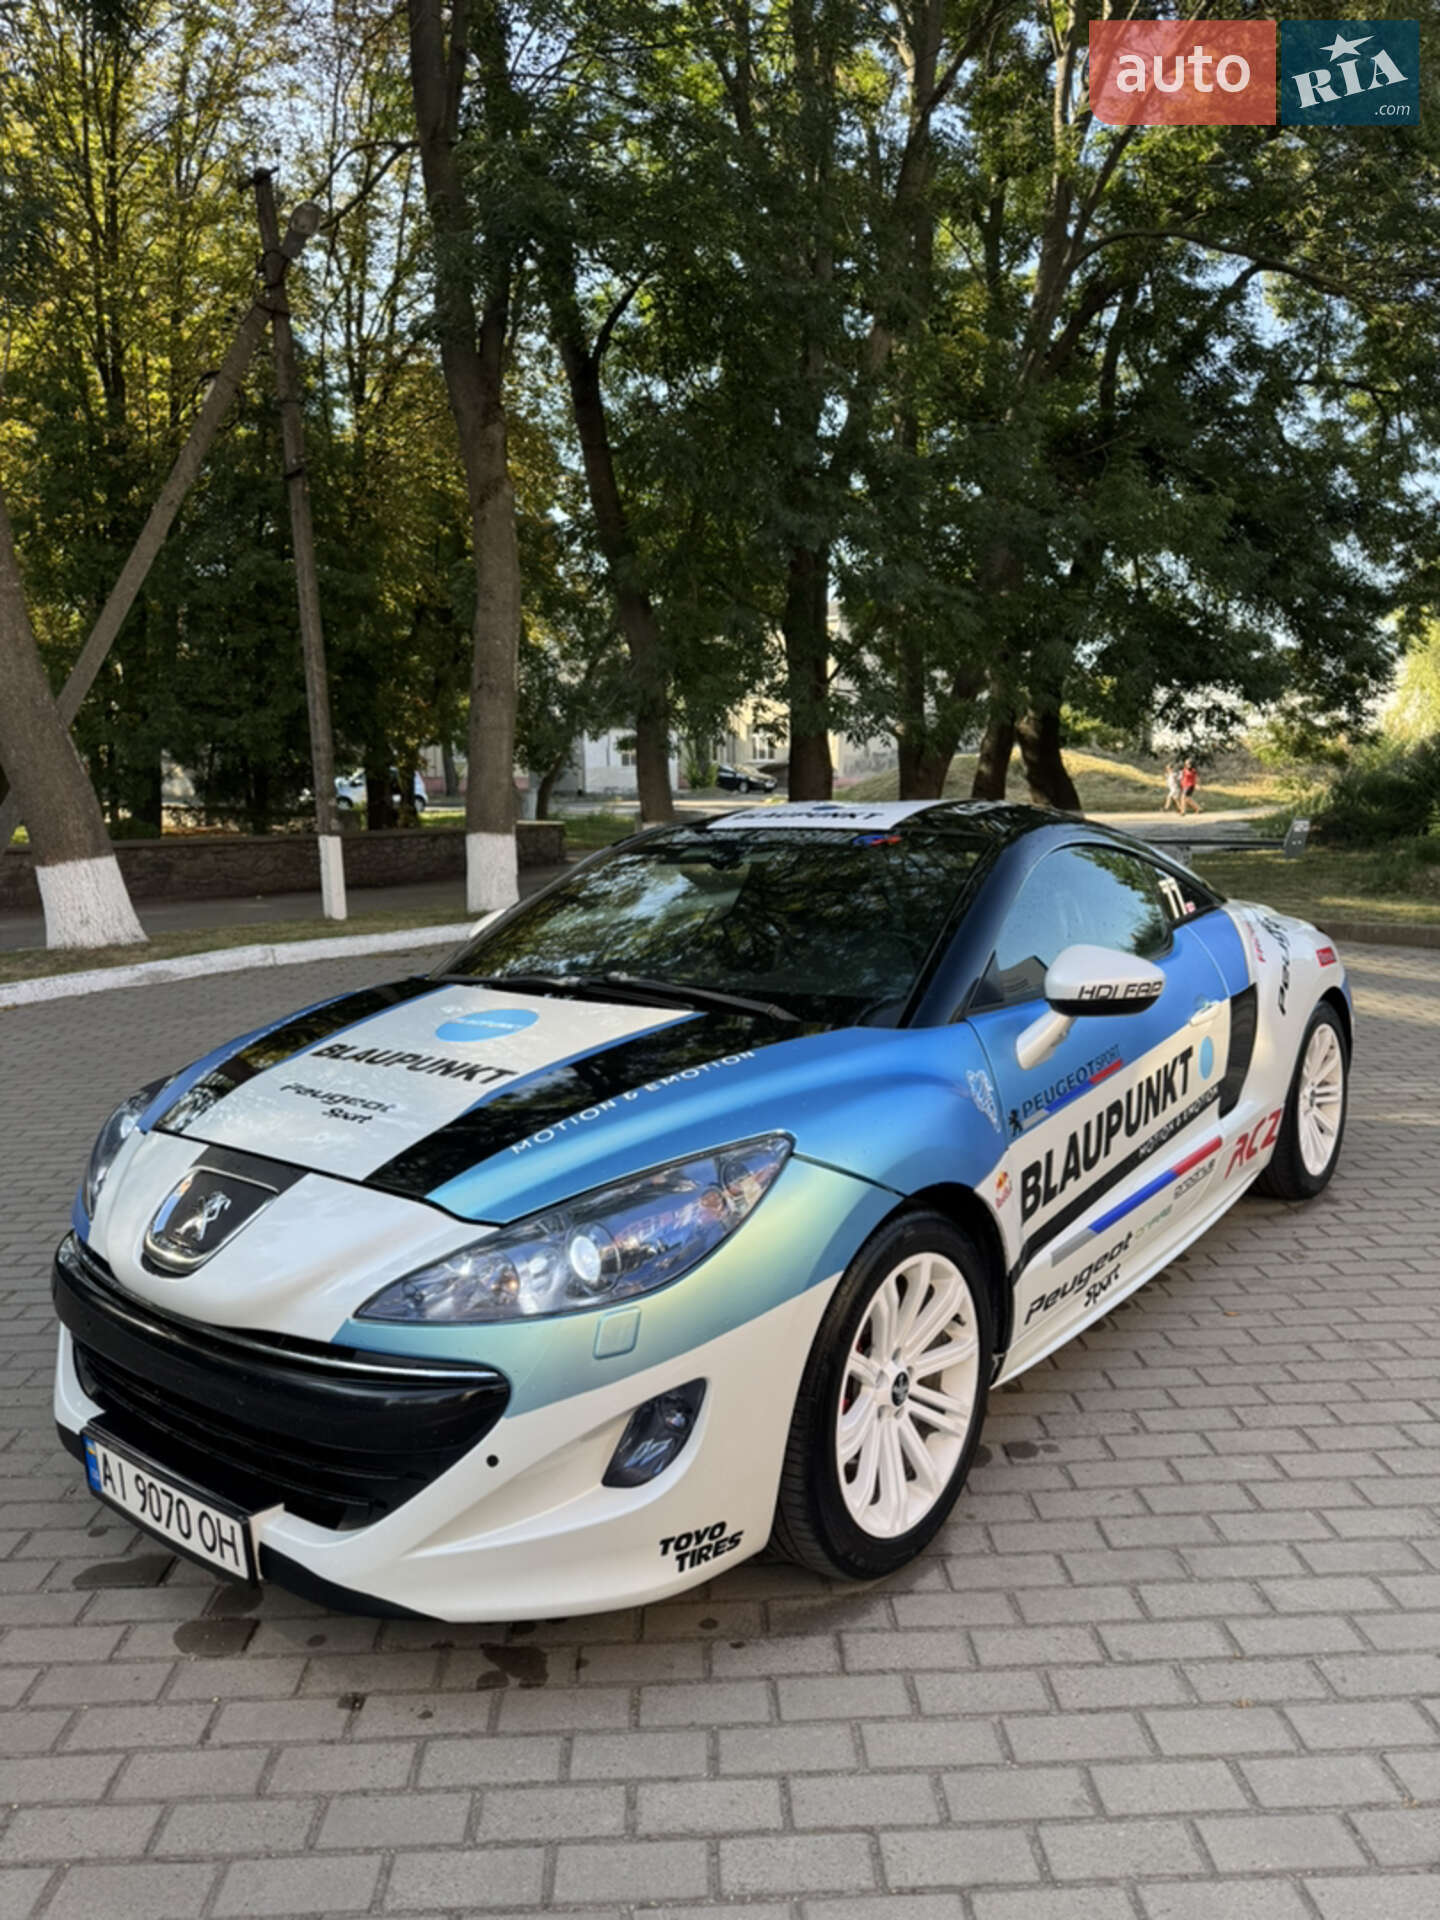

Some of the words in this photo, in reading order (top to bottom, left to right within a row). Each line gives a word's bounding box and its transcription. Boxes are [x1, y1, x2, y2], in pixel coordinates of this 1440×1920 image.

[1078, 984, 1119, 1000] HDI
[310, 1043, 520, 1085] BLAUPUNKT
[1022, 1061, 1095, 1119] PEUGEOT
[511, 1099, 617, 1155] MOTION
[643, 1050, 756, 1092] EMOTION
[1021, 1045, 1194, 1227] BLAUPUNKT
[1024, 1231, 1133, 1326] Peugeot
[102, 1452, 127, 1501] AI
[134, 1473, 193, 1541] 9070
[198, 1510, 241, 1568] OH
[659, 1520, 727, 1557] TOYO
[675, 1530, 744, 1573] TIRES
